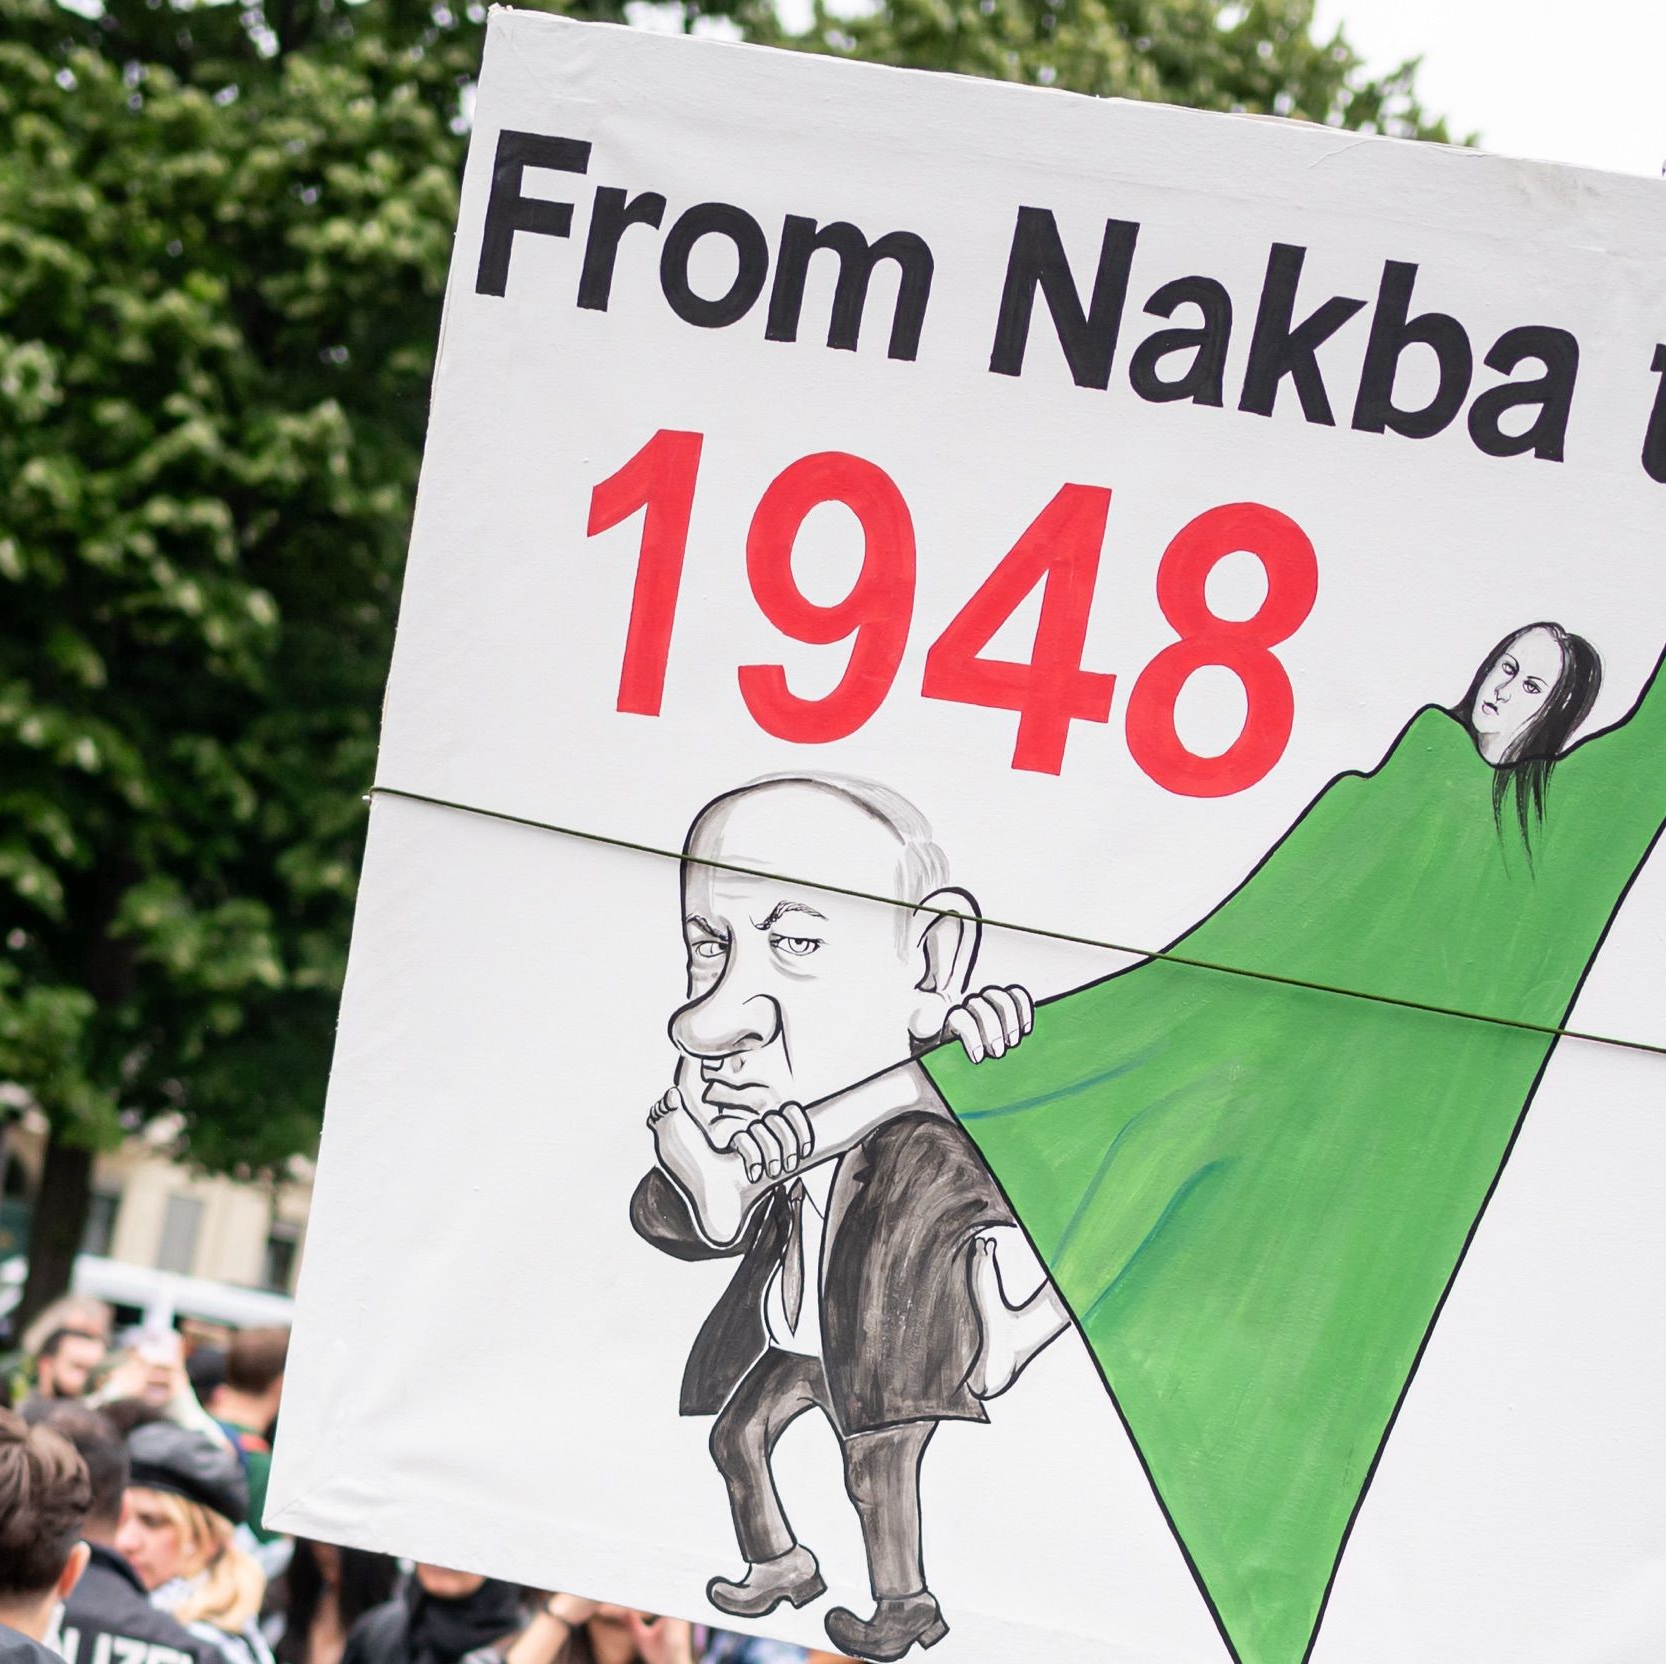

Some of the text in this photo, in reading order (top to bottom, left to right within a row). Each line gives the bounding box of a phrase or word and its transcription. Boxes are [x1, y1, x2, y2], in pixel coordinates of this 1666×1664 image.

[475, 129, 935, 362] From
[988, 205, 1580, 463] Nakba
[586, 429, 1318, 798] 1948
